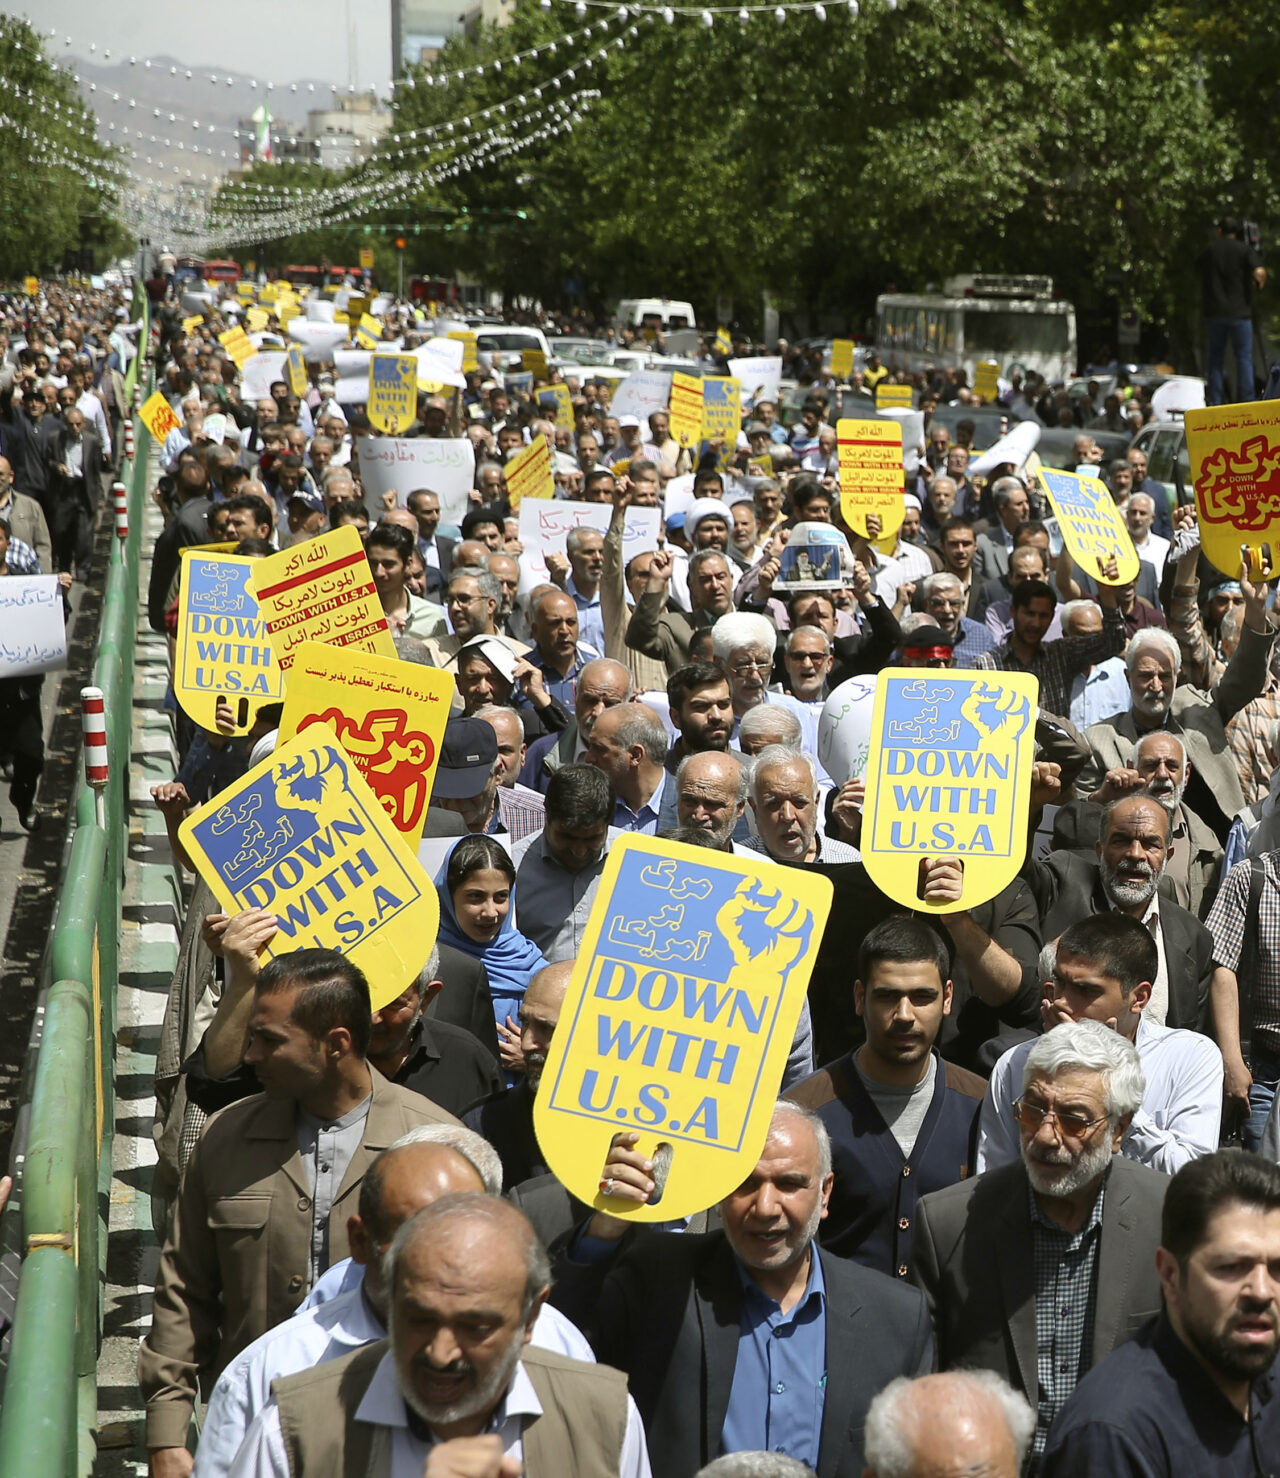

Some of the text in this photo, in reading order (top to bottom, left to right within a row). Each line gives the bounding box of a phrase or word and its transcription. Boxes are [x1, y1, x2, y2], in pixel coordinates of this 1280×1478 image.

[1061, 503, 1115, 525] DOWN
[1070, 519, 1117, 540] WITH
[270, 587, 371, 633] DOWN WITH U.S.A
[344, 623, 382, 645] ISRAEL
[196, 641, 272, 667] WITH
[195, 667, 270, 694] U.S.A
[902, 680, 955, 704] مرگ
[914, 705, 939, 724] بر
[886, 749, 1010, 780] DOWN
[892, 785, 997, 815] WITH
[890, 821, 995, 852] U.S.A
[241, 808, 367, 912] DOWN
[275, 847, 380, 939] WITH
[641, 860, 714, 900] مرگ
[649, 903, 685, 931] بر
[593, 958, 770, 1034] DOWN
[597, 1013, 741, 1085] WITH
[578, 1069, 720, 1141] U.S.A
